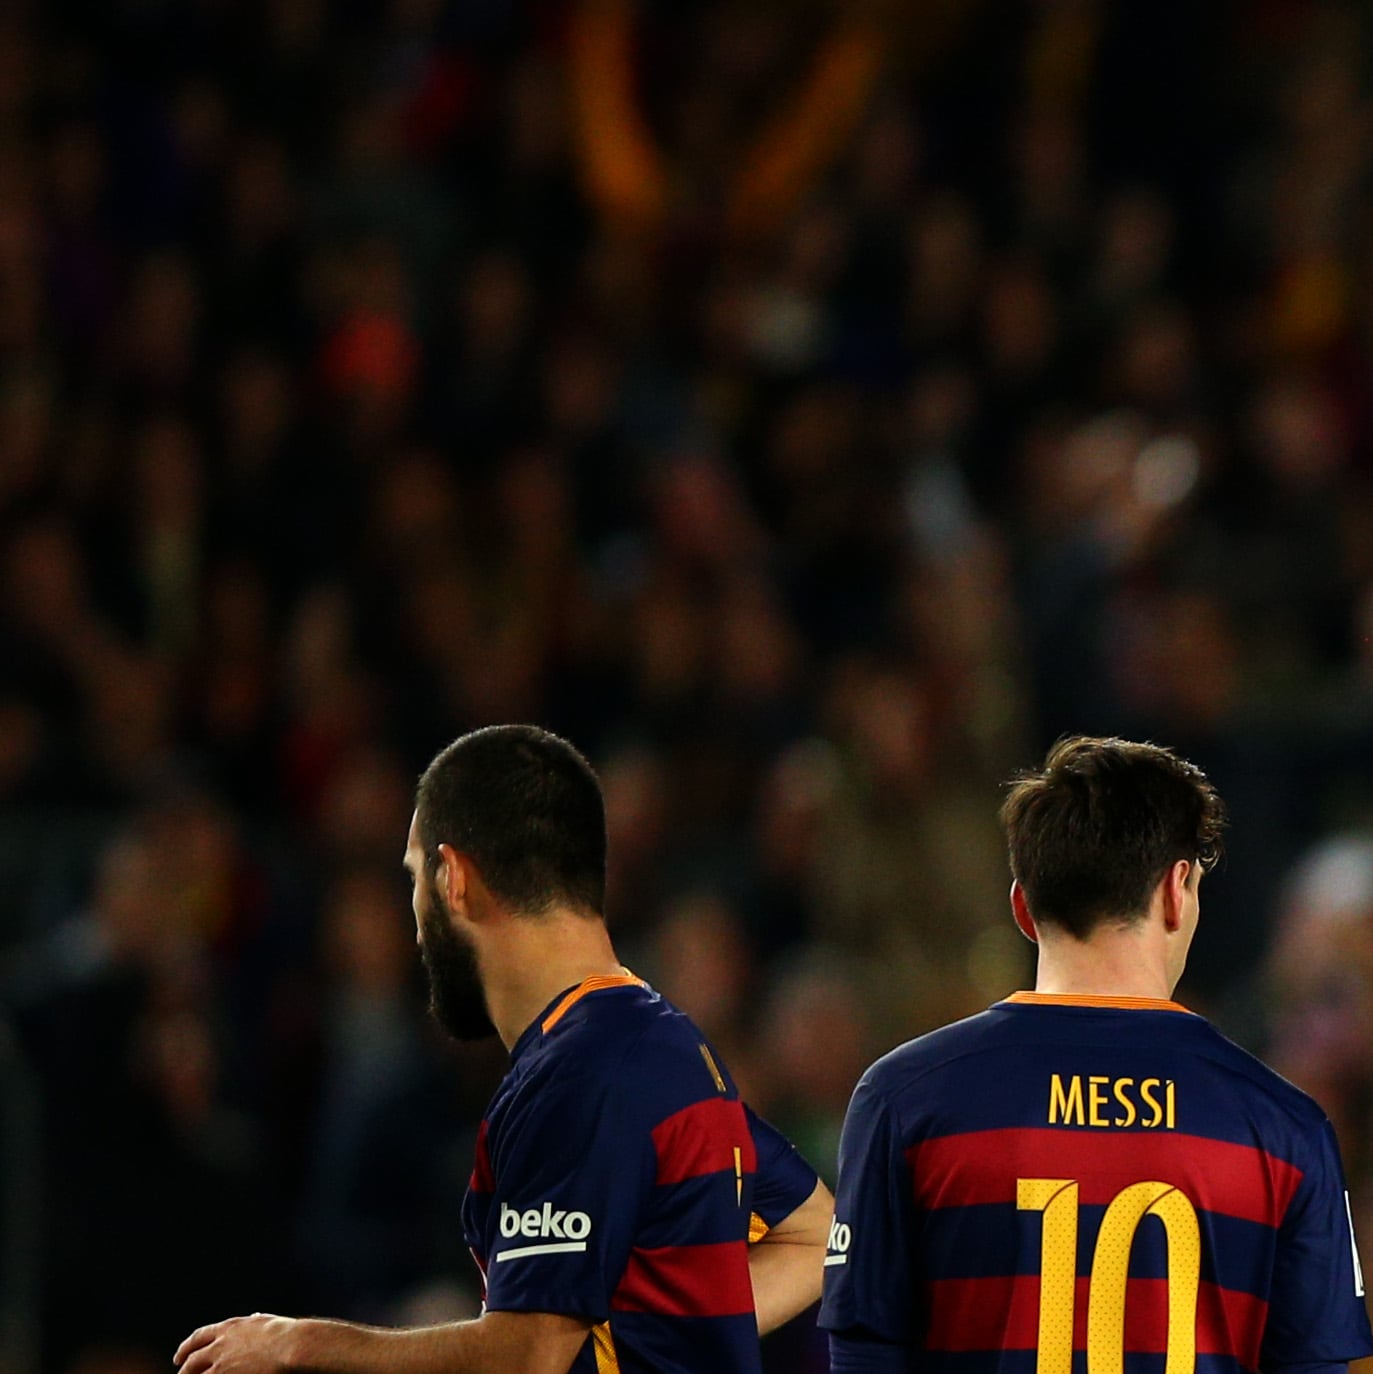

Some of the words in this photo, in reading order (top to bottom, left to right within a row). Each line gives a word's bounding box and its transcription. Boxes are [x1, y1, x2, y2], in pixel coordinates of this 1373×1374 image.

[1048, 1074, 1175, 1129] MESSI
[500, 1202, 592, 1240] beko
[827, 1213, 852, 1252] ko
